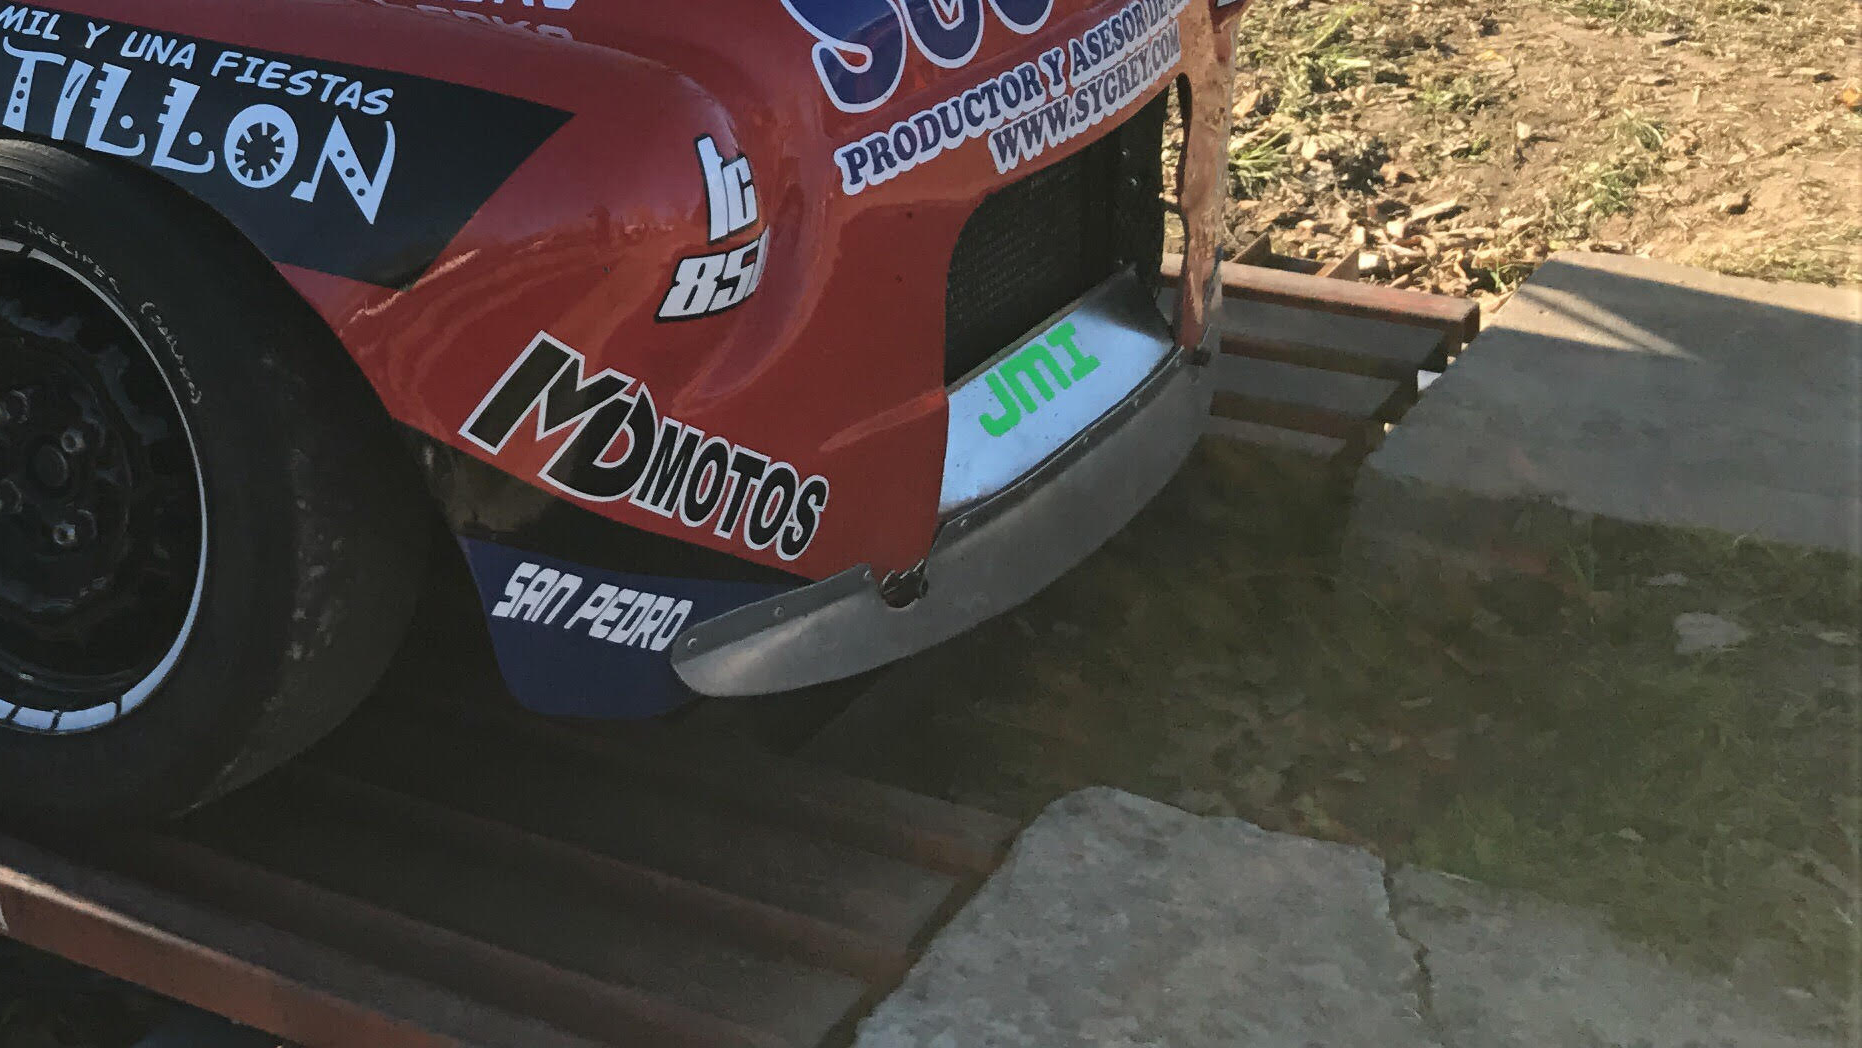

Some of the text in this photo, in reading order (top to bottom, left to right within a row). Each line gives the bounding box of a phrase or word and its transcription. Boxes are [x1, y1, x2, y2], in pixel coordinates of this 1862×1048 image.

[85, 22, 111, 50] Y
[120, 32, 196, 69] UNA
[210, 52, 395, 115] FIESTAS
[836, 64, 1045, 193] PRODUCTOR
[1040, 47, 1066, 96] Y
[1068, 0, 1148, 88] ASESOR
[988, 19, 1181, 175] WWW.SYGREY.COM
[458, 330, 831, 563] MD MOTOS
[492, 560, 694, 653] SAN PEDRO
